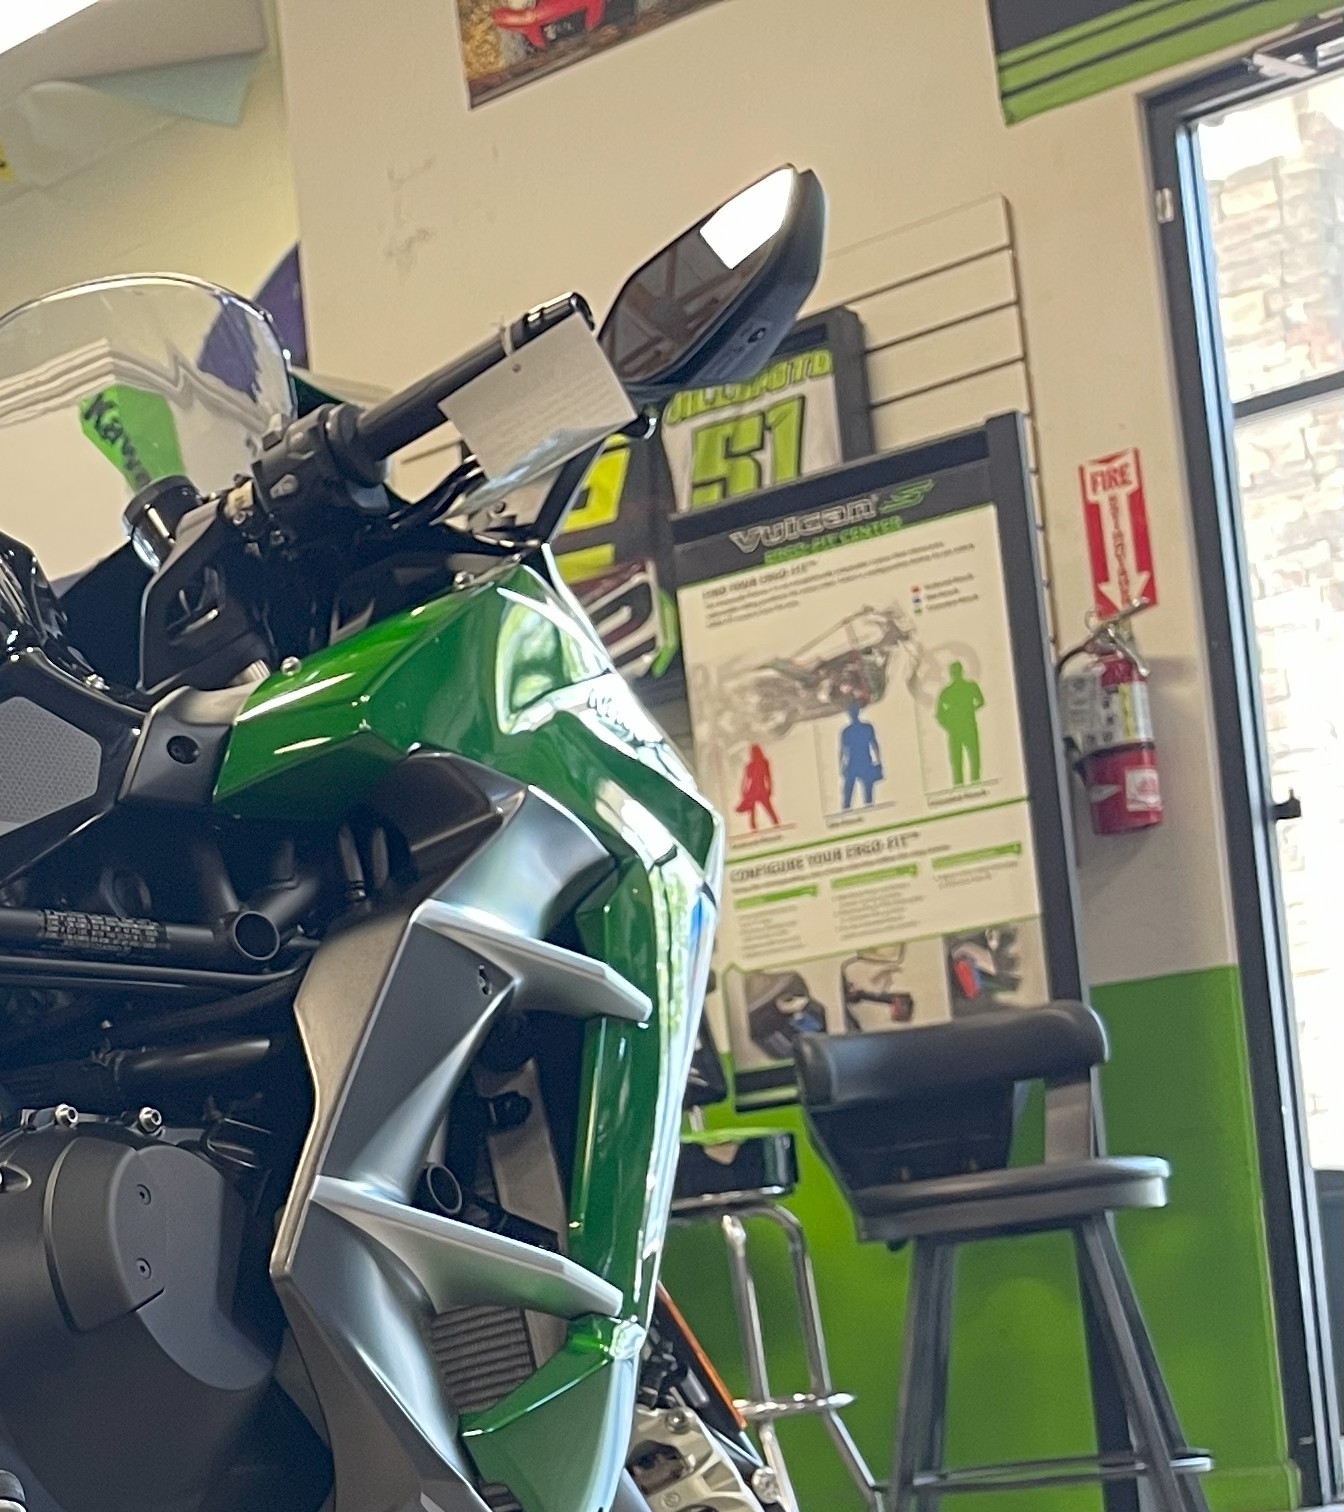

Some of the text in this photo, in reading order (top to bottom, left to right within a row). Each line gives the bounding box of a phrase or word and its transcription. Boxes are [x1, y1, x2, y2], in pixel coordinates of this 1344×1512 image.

[691, 393, 806, 507] 51
[1090, 462, 1132, 496] FIRE
[728, 499, 876, 554] Vulcan
